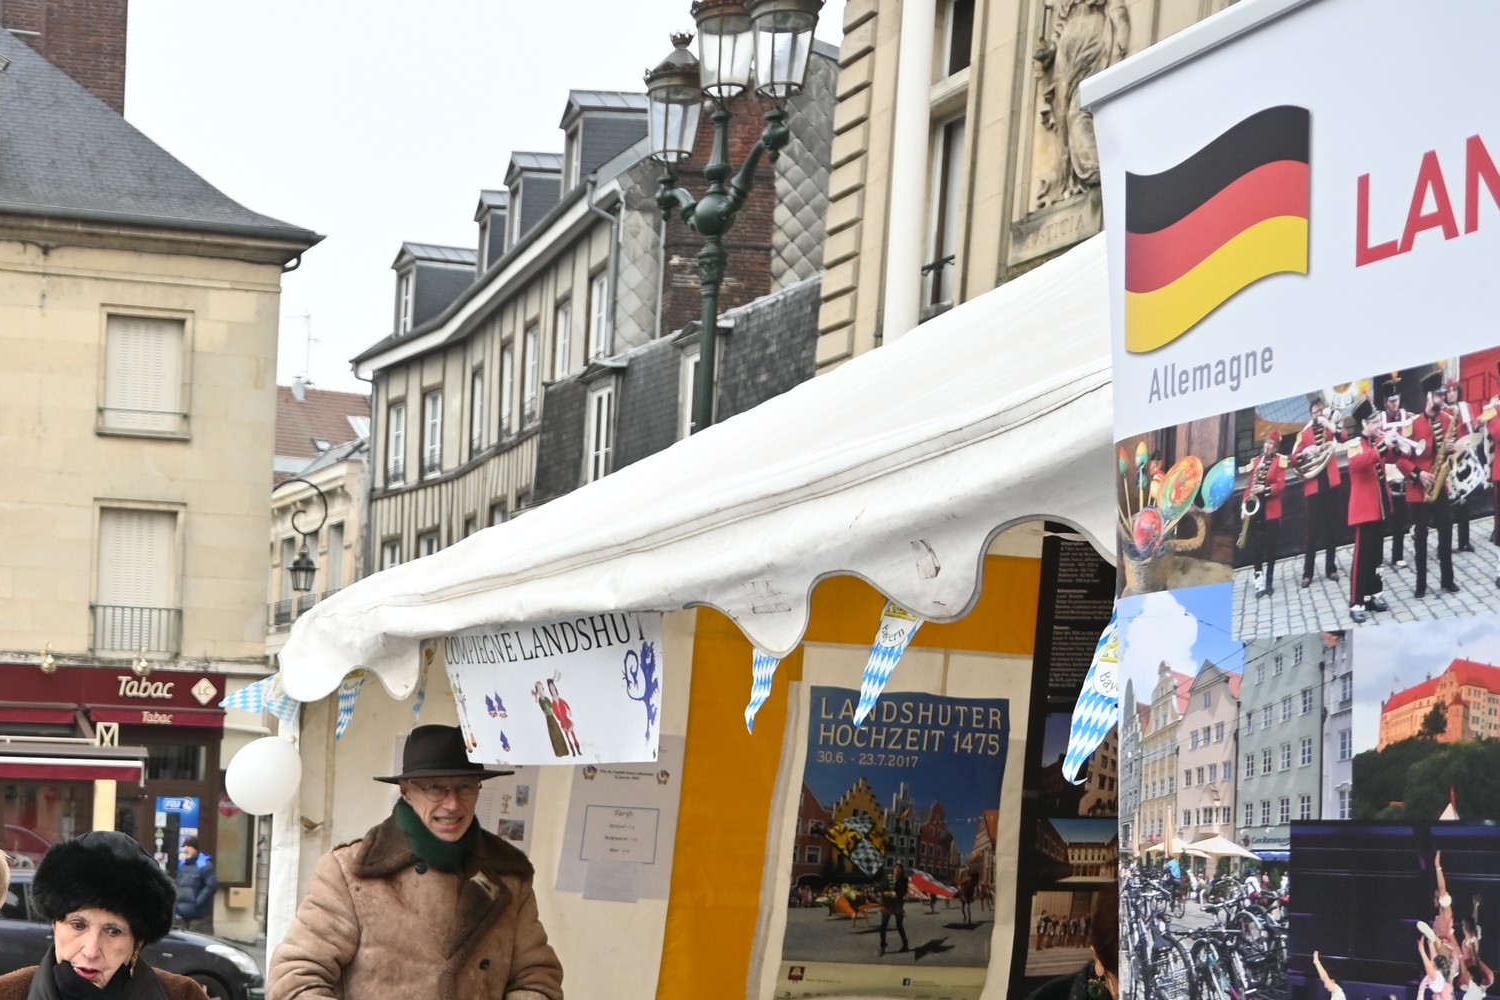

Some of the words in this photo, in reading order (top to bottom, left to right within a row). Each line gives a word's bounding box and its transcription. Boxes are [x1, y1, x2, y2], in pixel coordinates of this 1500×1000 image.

[1148, 345, 1274, 404] Allemagne
[444, 632, 518, 666] COMPIEGNE
[117, 675, 175, 700] Tabac
[141, 710, 173, 726] Tabac
[820, 697, 1002, 730] LANDSHUTER
[818, 723, 946, 753] HOCHZEIT
[953, 730, 1001, 756] 1475
[816, 750, 847, 765] 30.6.
[858, 752, 920, 769] 23.7.2017
